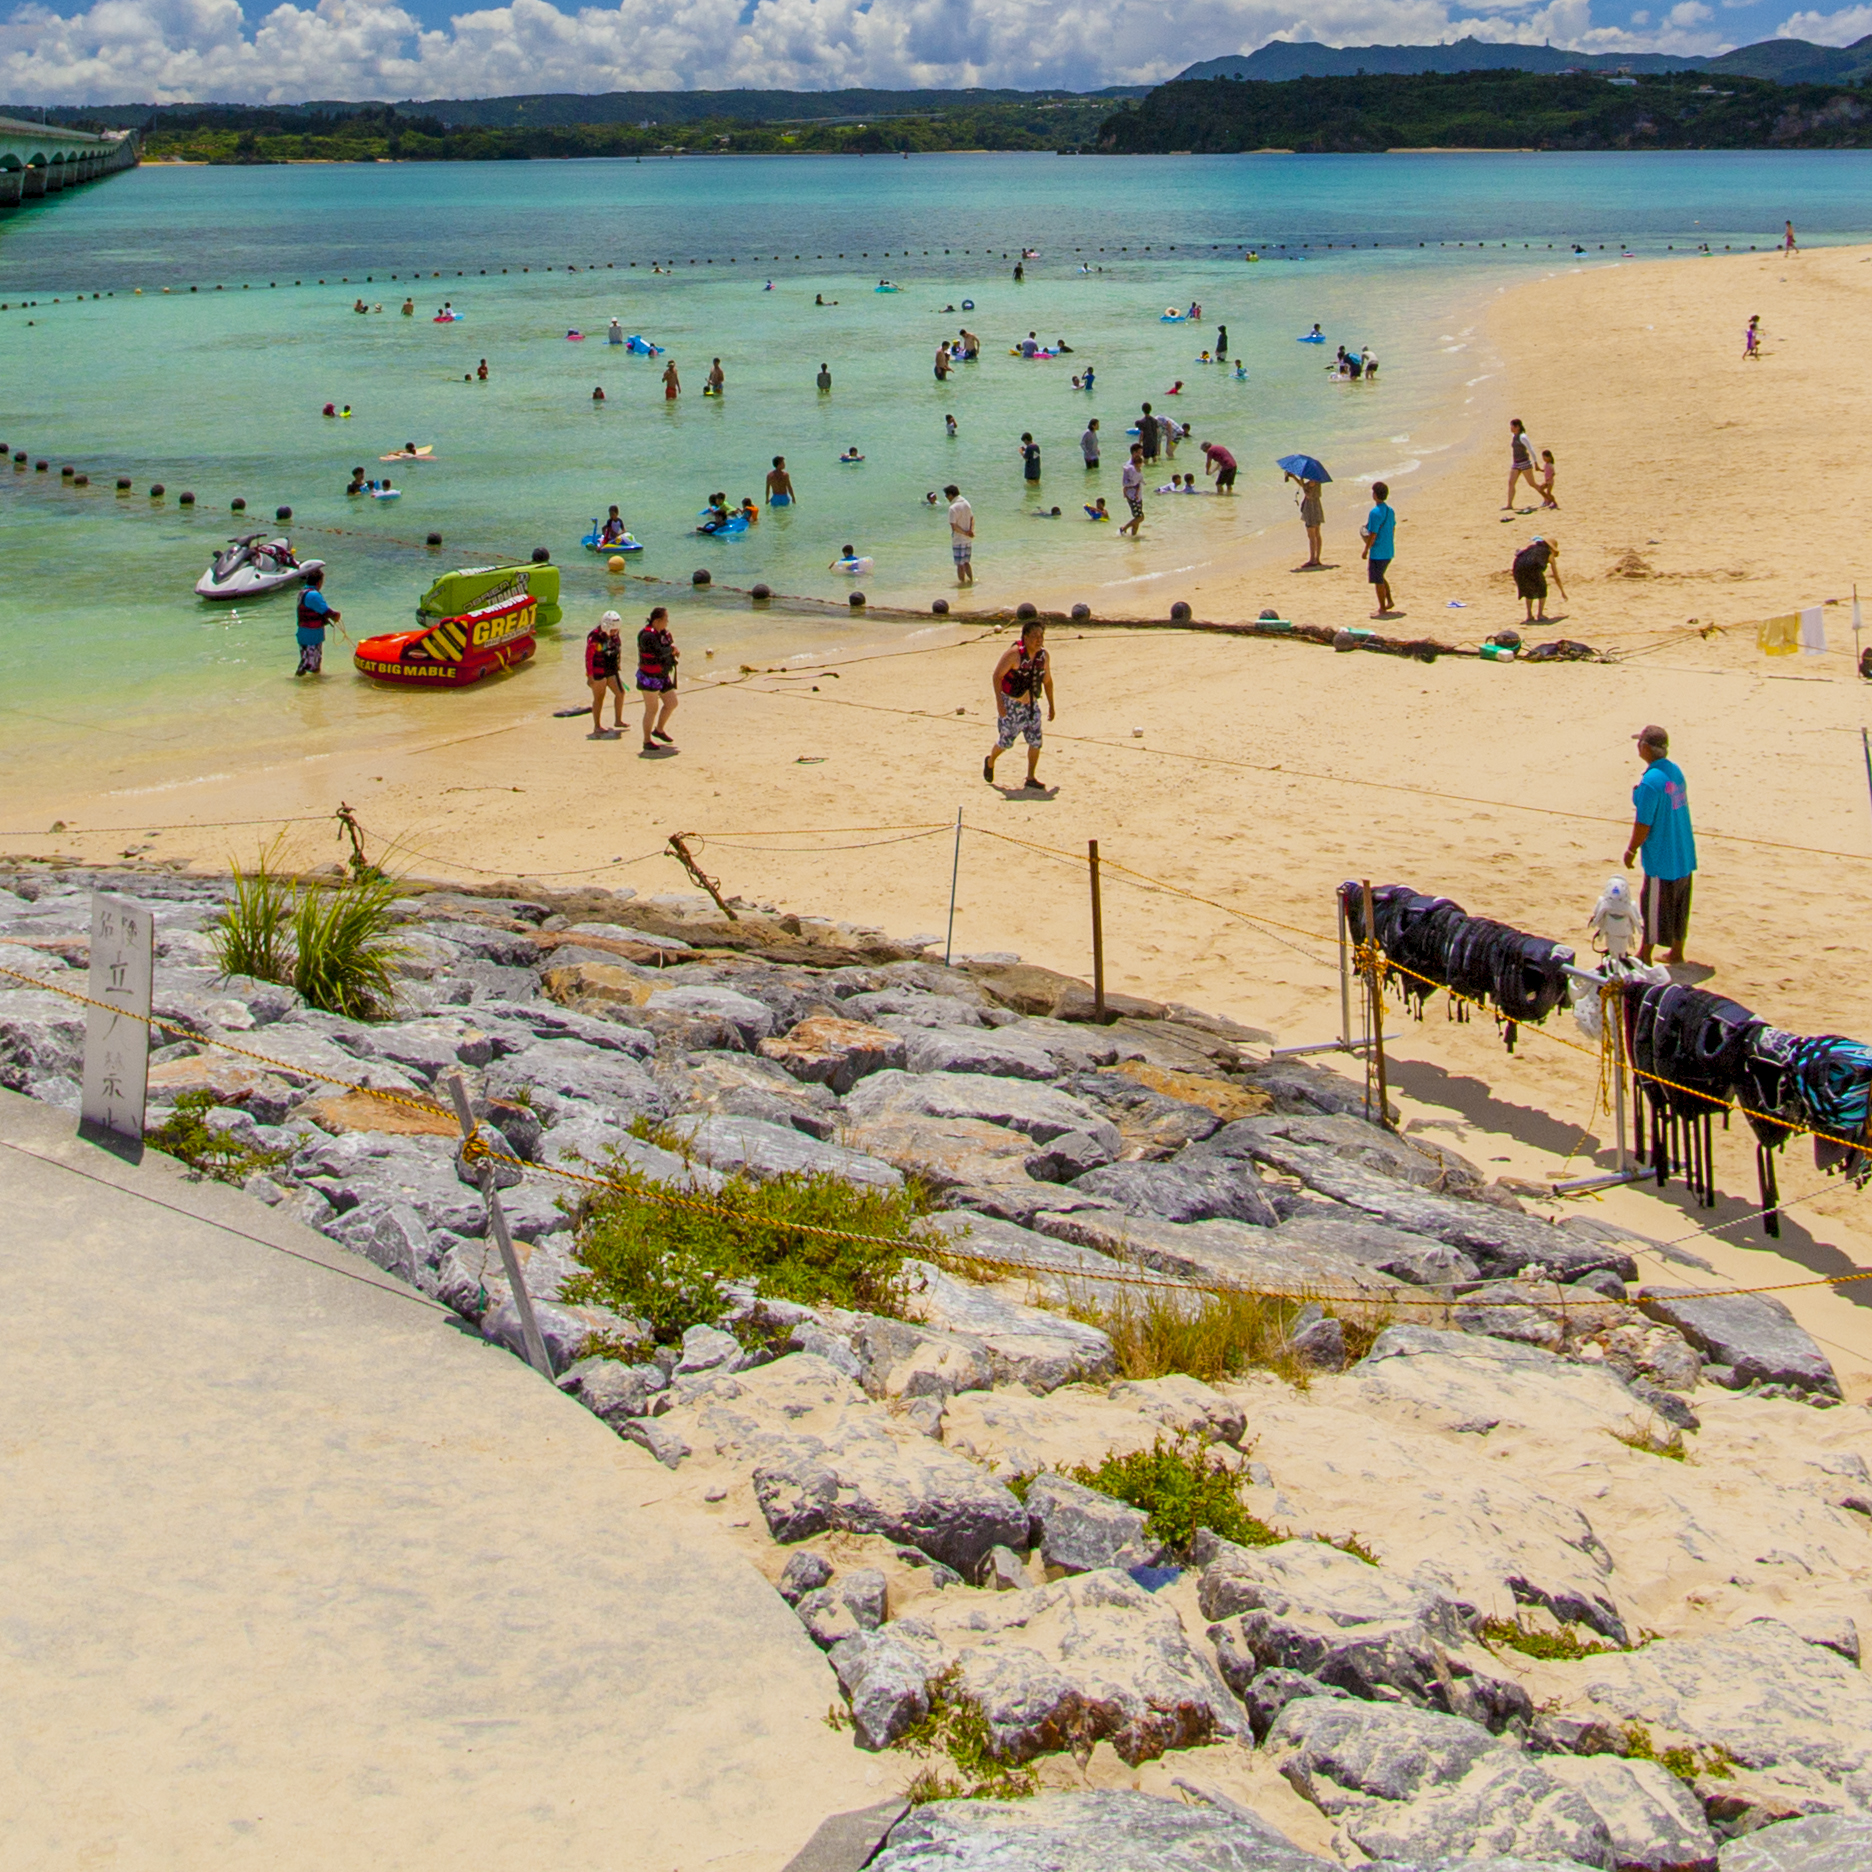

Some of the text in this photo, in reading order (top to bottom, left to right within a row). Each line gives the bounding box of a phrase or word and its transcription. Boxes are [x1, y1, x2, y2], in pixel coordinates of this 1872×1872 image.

[473, 603, 538, 646] GREAT
[378, 663, 402, 675] BIG
[403, 665, 457, 678] MABLE
